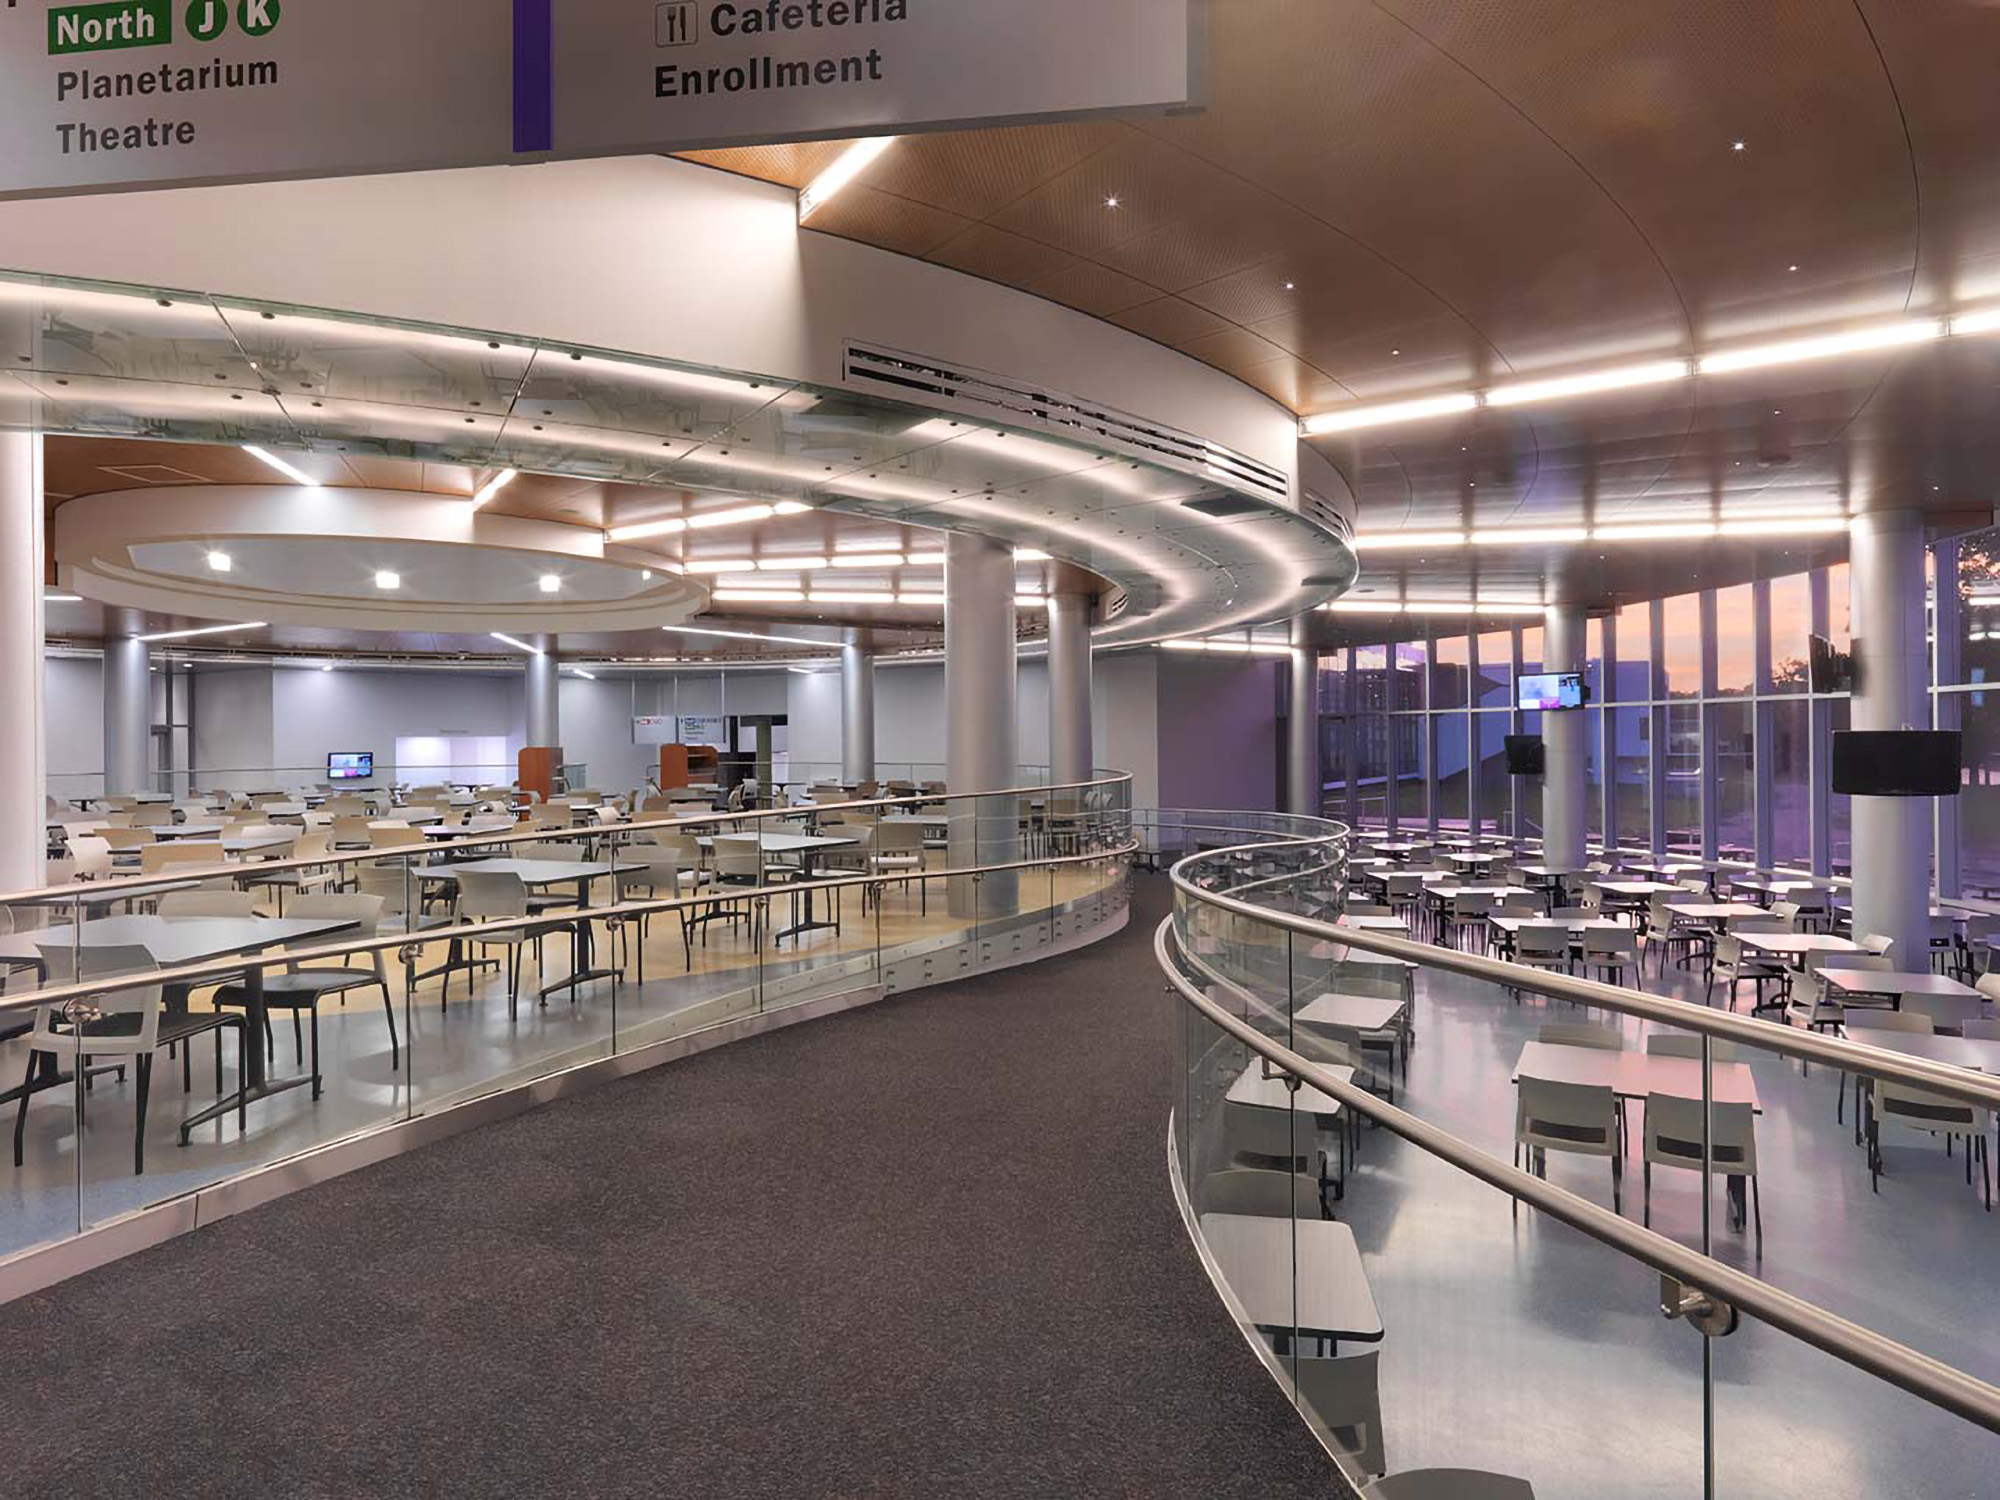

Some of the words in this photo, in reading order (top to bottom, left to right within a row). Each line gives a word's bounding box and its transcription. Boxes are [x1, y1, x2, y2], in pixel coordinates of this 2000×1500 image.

[56, 9, 156, 46] North
[198, 0, 215, 33] J
[247, 0, 272, 28] K
[711, 0, 907, 36] Cafeteria
[57, 59, 278, 101] Planetarium
[655, 49, 882, 98] Enrollment
[56, 118, 195, 154] Theatre
